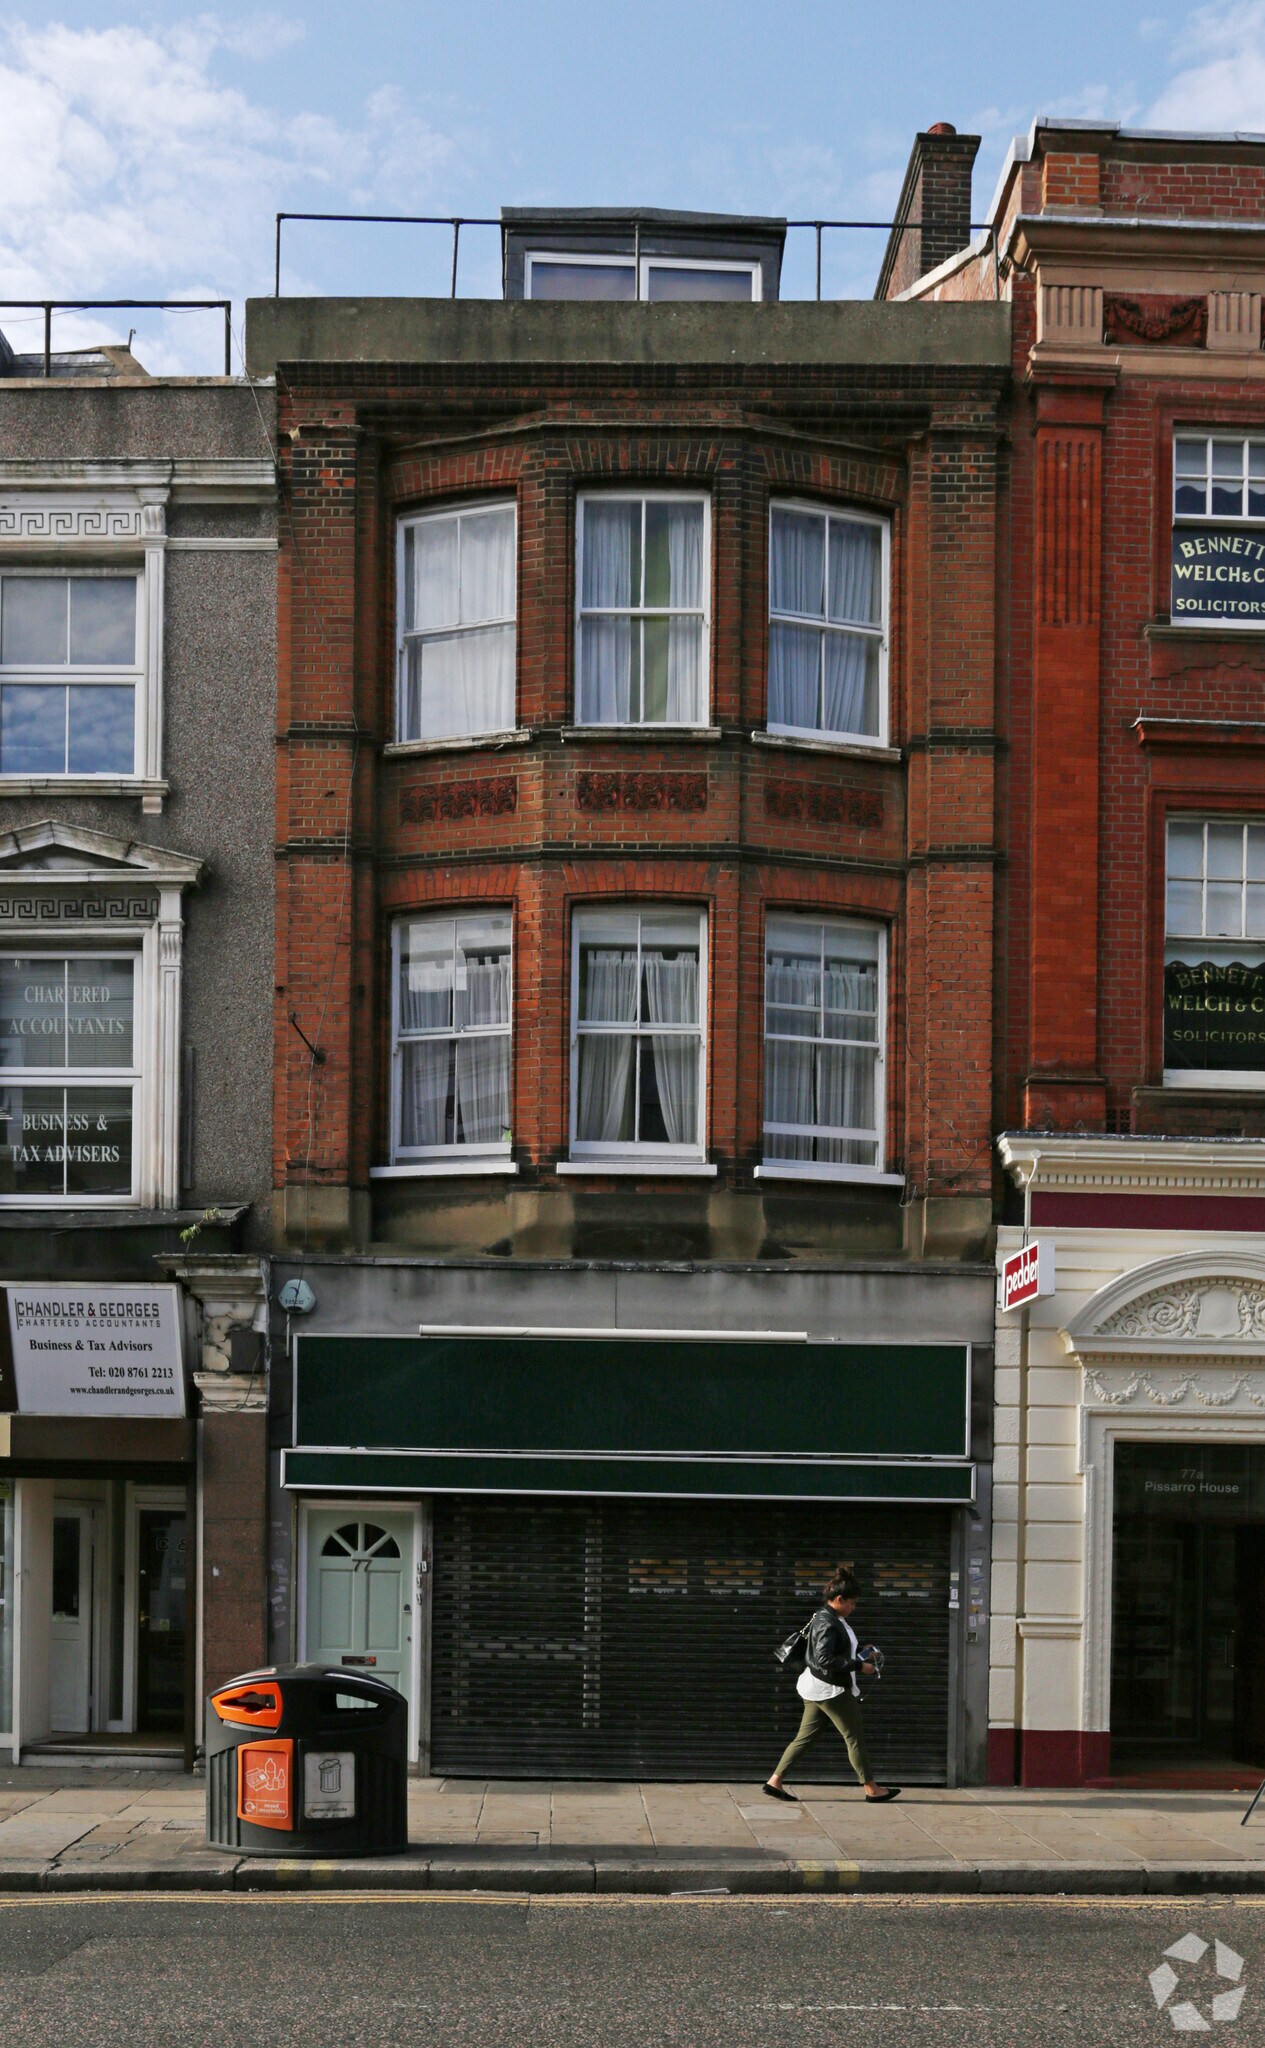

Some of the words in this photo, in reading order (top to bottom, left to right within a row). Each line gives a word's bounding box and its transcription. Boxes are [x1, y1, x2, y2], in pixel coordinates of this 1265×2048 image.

[1180, 537, 1265, 560] BENNETT
[24, 985, 110, 1003] CHARERED
[1168, 995, 1230, 1012] WELCH
[1235, 1000, 1247, 1012] &
[23, 1113, 89, 1131] BUSINESS
[96, 1114, 108, 1131] &
[10, 1145, 41, 1162] TAX
[44, 1145, 120, 1162] ADVISERS
[17, 1301, 84, 1317] CHANDLER
[87, 1302, 96, 1317] &
[99, 1302, 160, 1317] GEORGES
[18, 1319, 80, 1327] CHARTERED
[85, 1319, 161, 1328] ACCOUNTANTS
[29, 1339, 72, 1351] Business
[75, 1340, 84, 1351] &
[87, 1340, 105, 1351] Tax
[109, 1340, 153, 1352] Advisors
[88, 1366, 106, 1378] Tel:
[108, 1367, 125, 1378] 020
[127, 1367, 148, 1378] 8761
[152, 1367, 174, 1379] 2213
[70, 1386, 175, 1397] www.chandlerandgeorges.co.uk
[1181, 1469, 1204, 1480] 77a
[1145, 1481, 1196, 1493] Pissarro
[1199, 1482, 1240, 1493] House
[352, 1558, 373, 1573] 77
